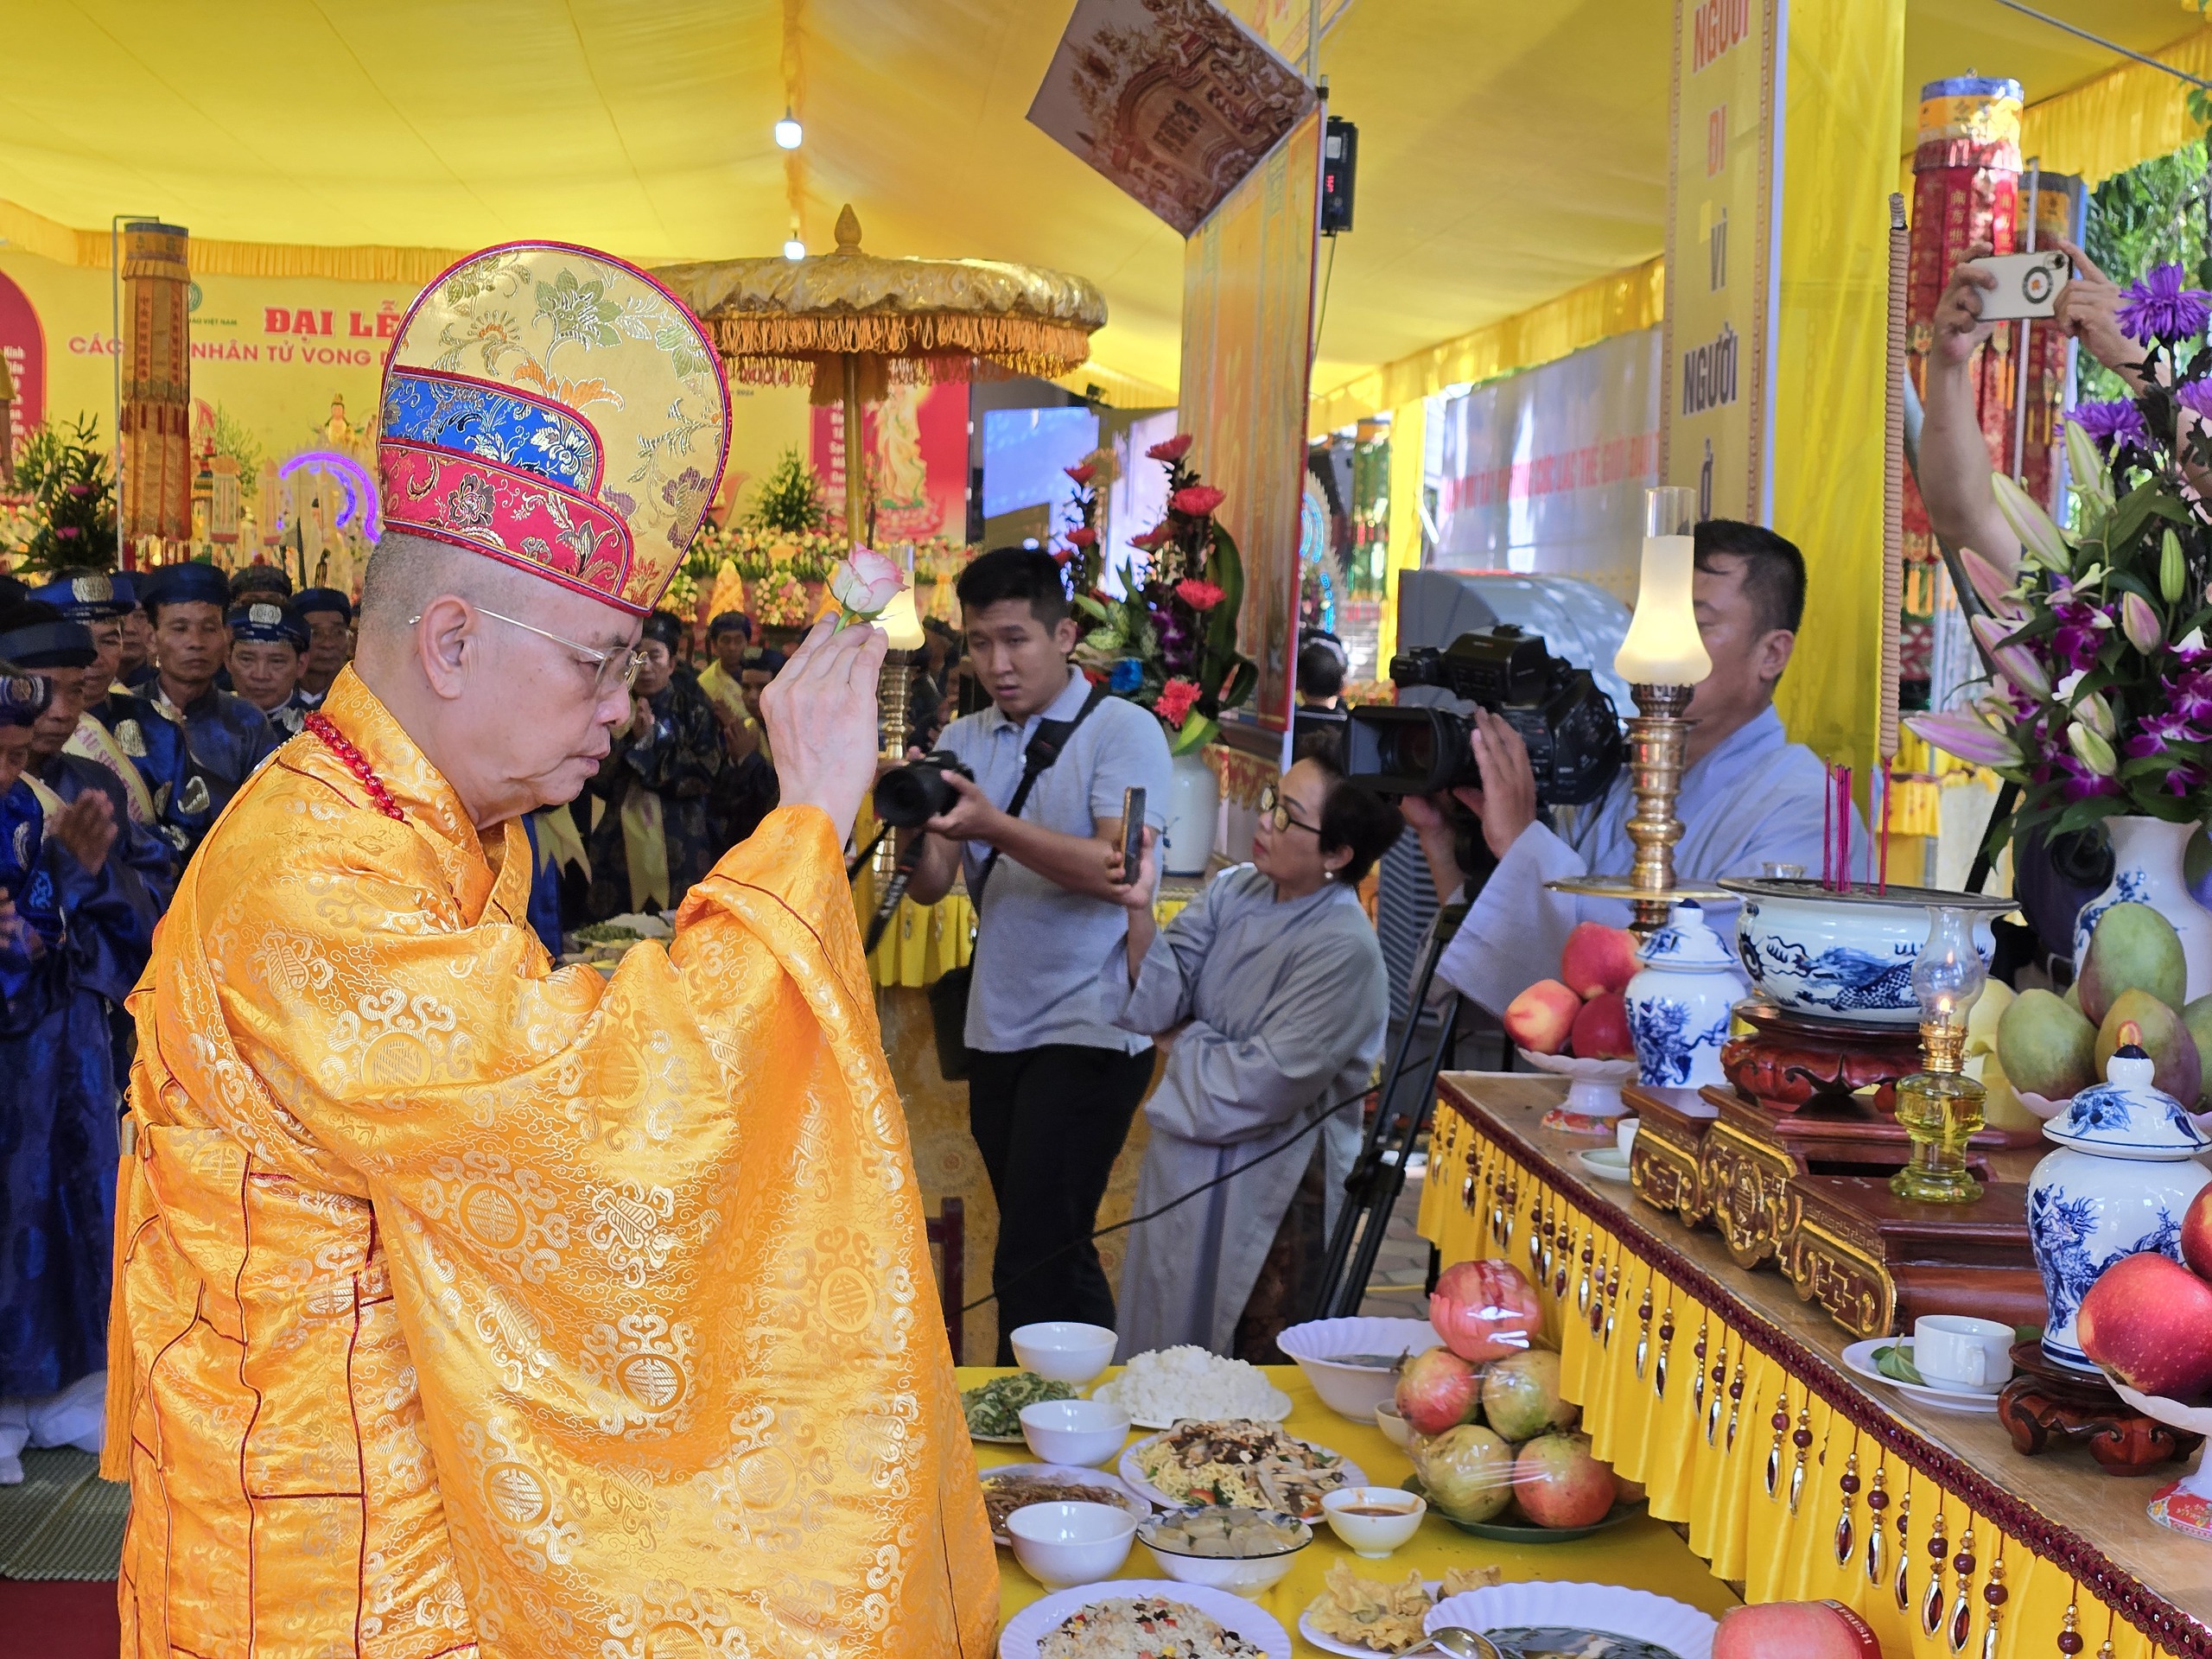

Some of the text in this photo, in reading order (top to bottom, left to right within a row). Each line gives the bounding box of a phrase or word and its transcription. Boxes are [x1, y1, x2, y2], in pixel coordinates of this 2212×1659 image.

[1710, 207, 1727, 292] VÌ
[264, 300, 400, 341] ĐẠI LỄ
[68, 333, 124, 355] CÁC
[191, 340, 258, 361] NHÂN
[266, 340, 295, 362] TỬ
[302, 347, 372, 366] VONG
[1682, 321, 1738, 415] NGƯỜI
[1838, 1608, 1872, 1644] FRESH
